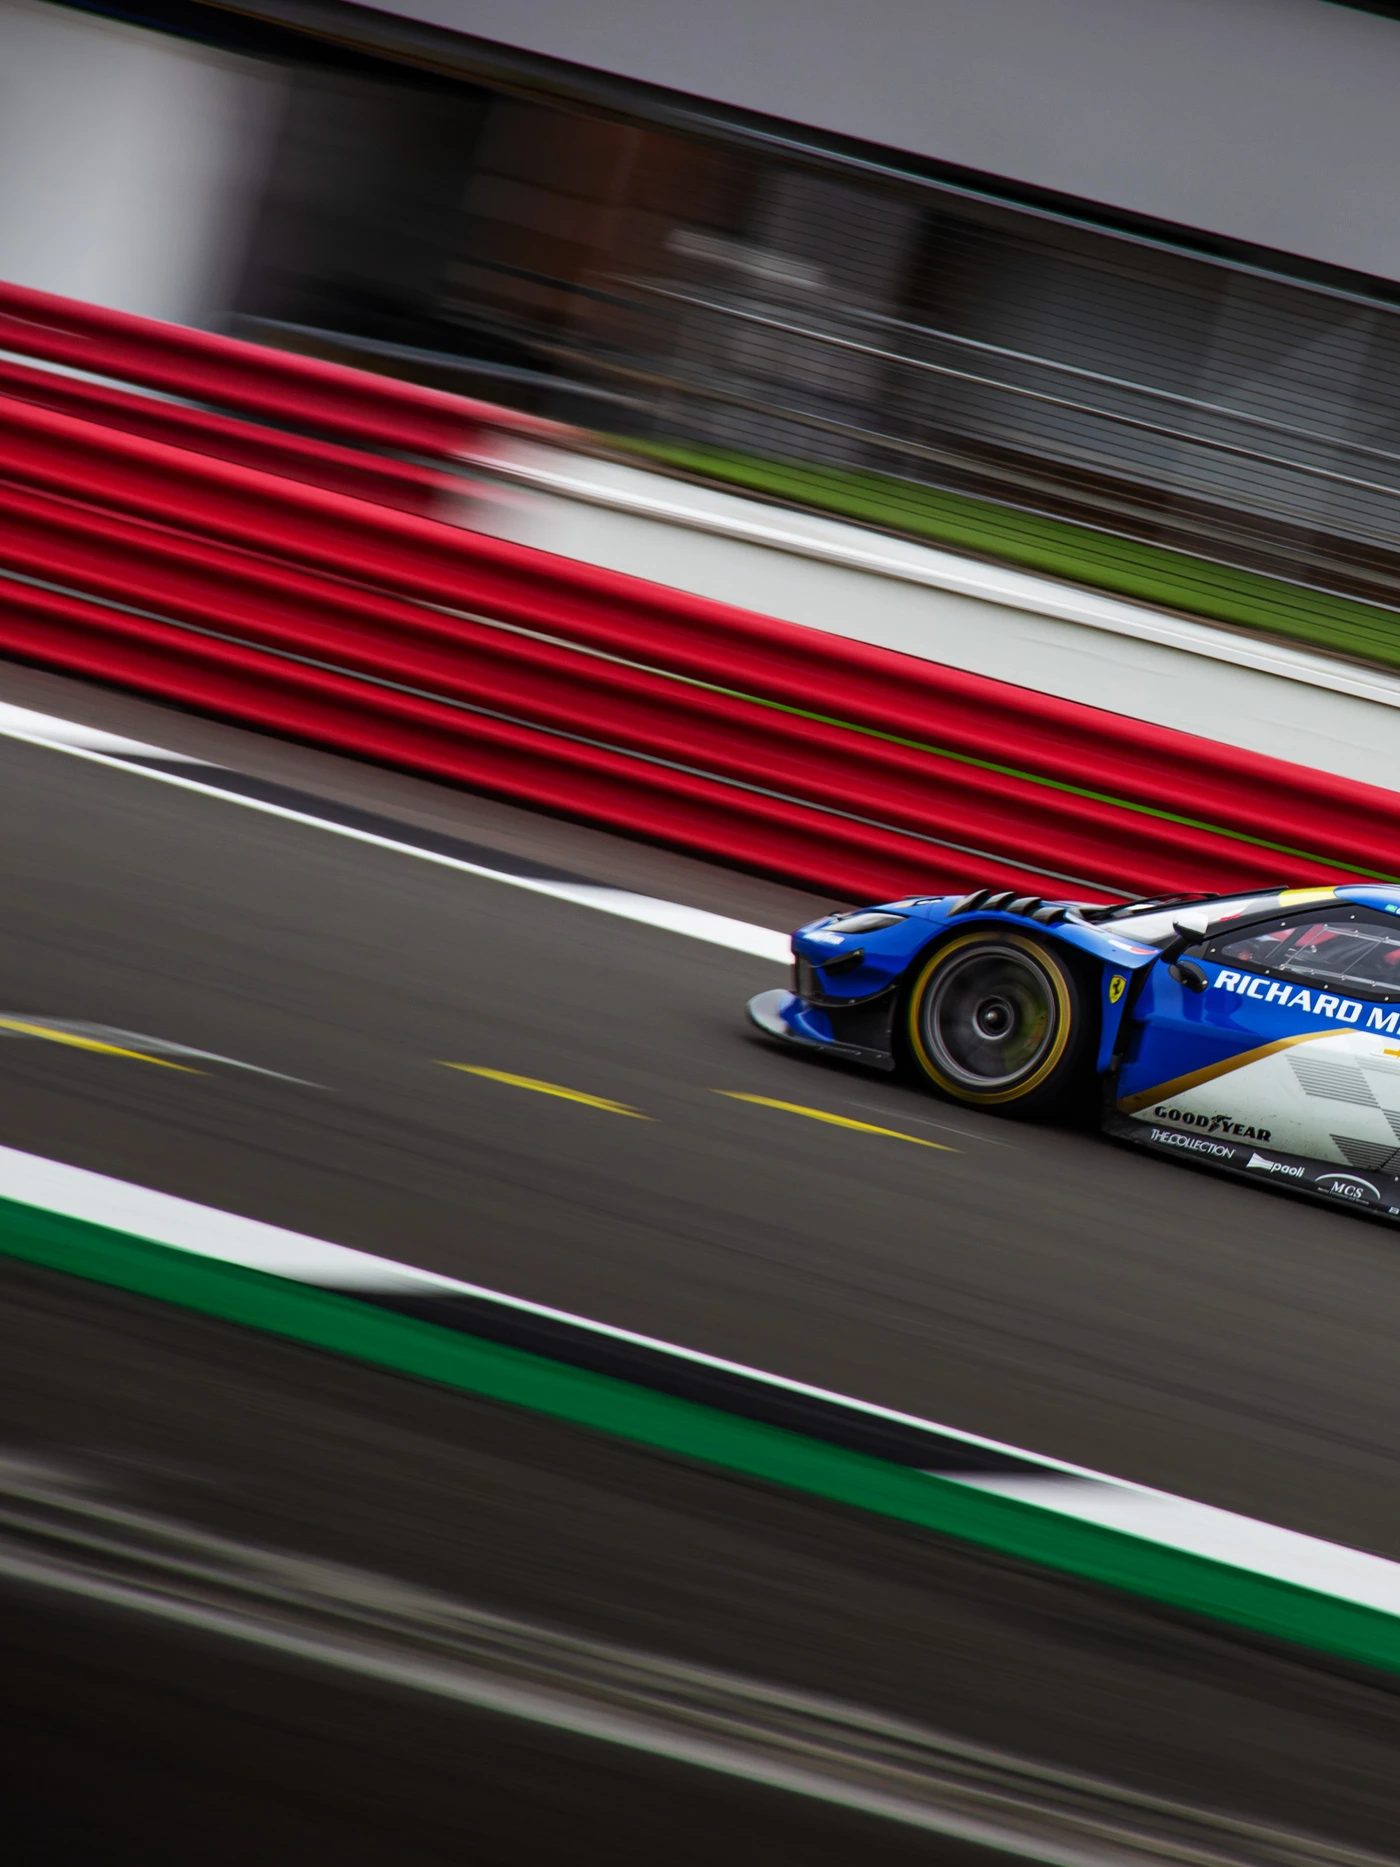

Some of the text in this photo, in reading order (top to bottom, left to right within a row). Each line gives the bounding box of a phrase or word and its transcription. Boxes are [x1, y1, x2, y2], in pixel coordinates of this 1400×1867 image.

[1214, 970, 1363, 1023] RICHARD
[1154, 1105, 1272, 1142] GOODYEAR
[1270, 1162, 1305, 1178] paoli
[1331, 1181, 1364, 1199] MCS
